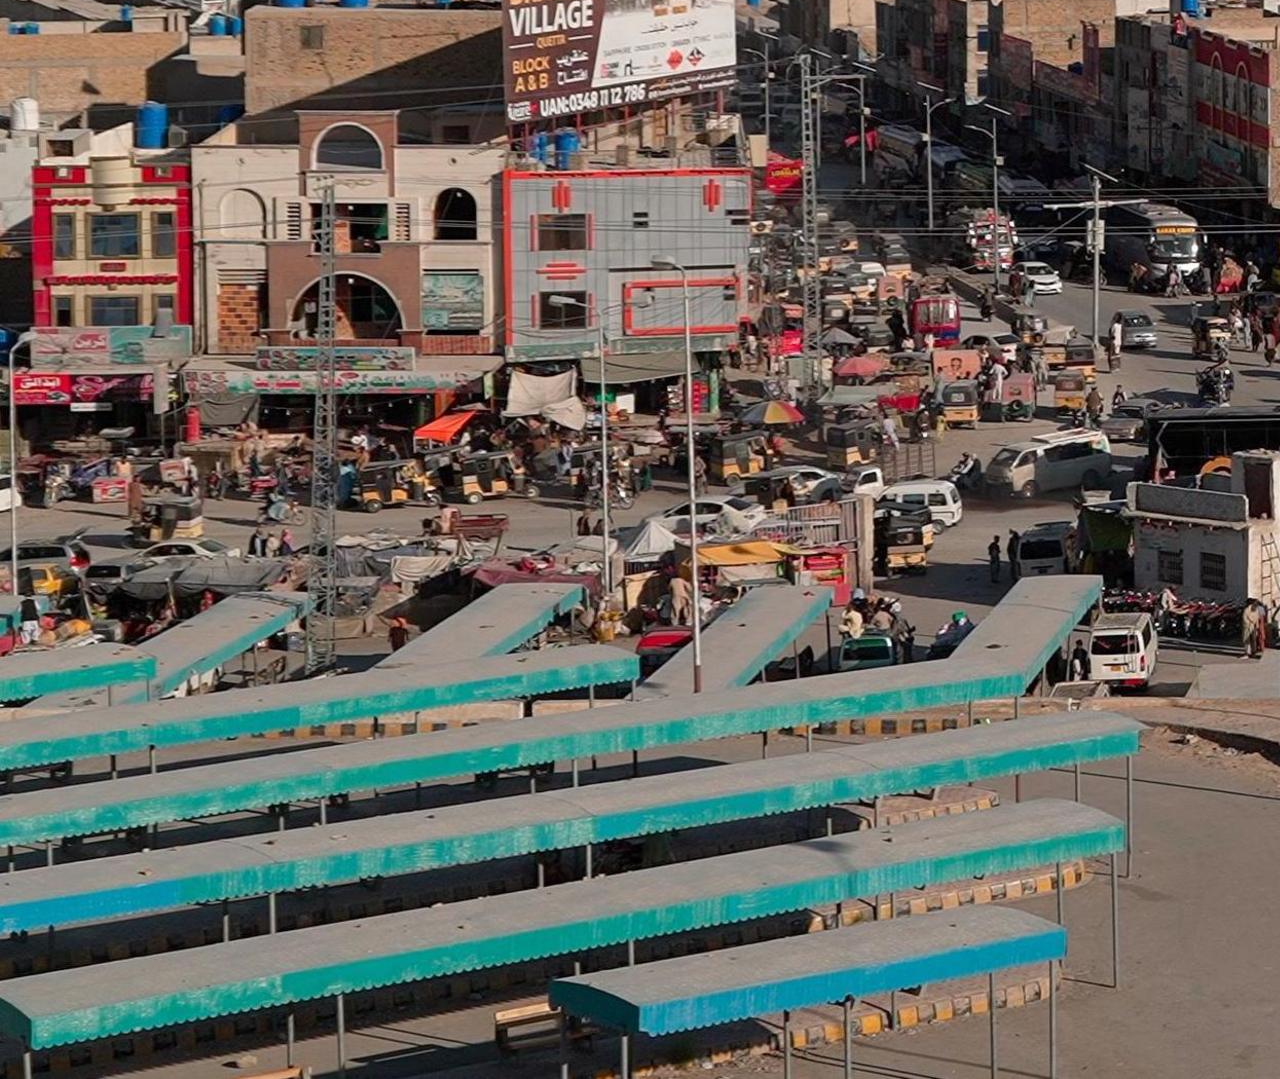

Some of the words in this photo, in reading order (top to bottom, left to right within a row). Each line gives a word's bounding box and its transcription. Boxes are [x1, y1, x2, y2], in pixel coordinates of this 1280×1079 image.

[509, 0, 593, 36] VILLAGE
[512, 56, 551, 74] BLOCK
[514, 77, 526, 93] A
[527, 75, 538, 91] &
[539, 73, 549, 89] B
[611, 85, 622, 104] 12
[624, 83, 646, 102] 786
